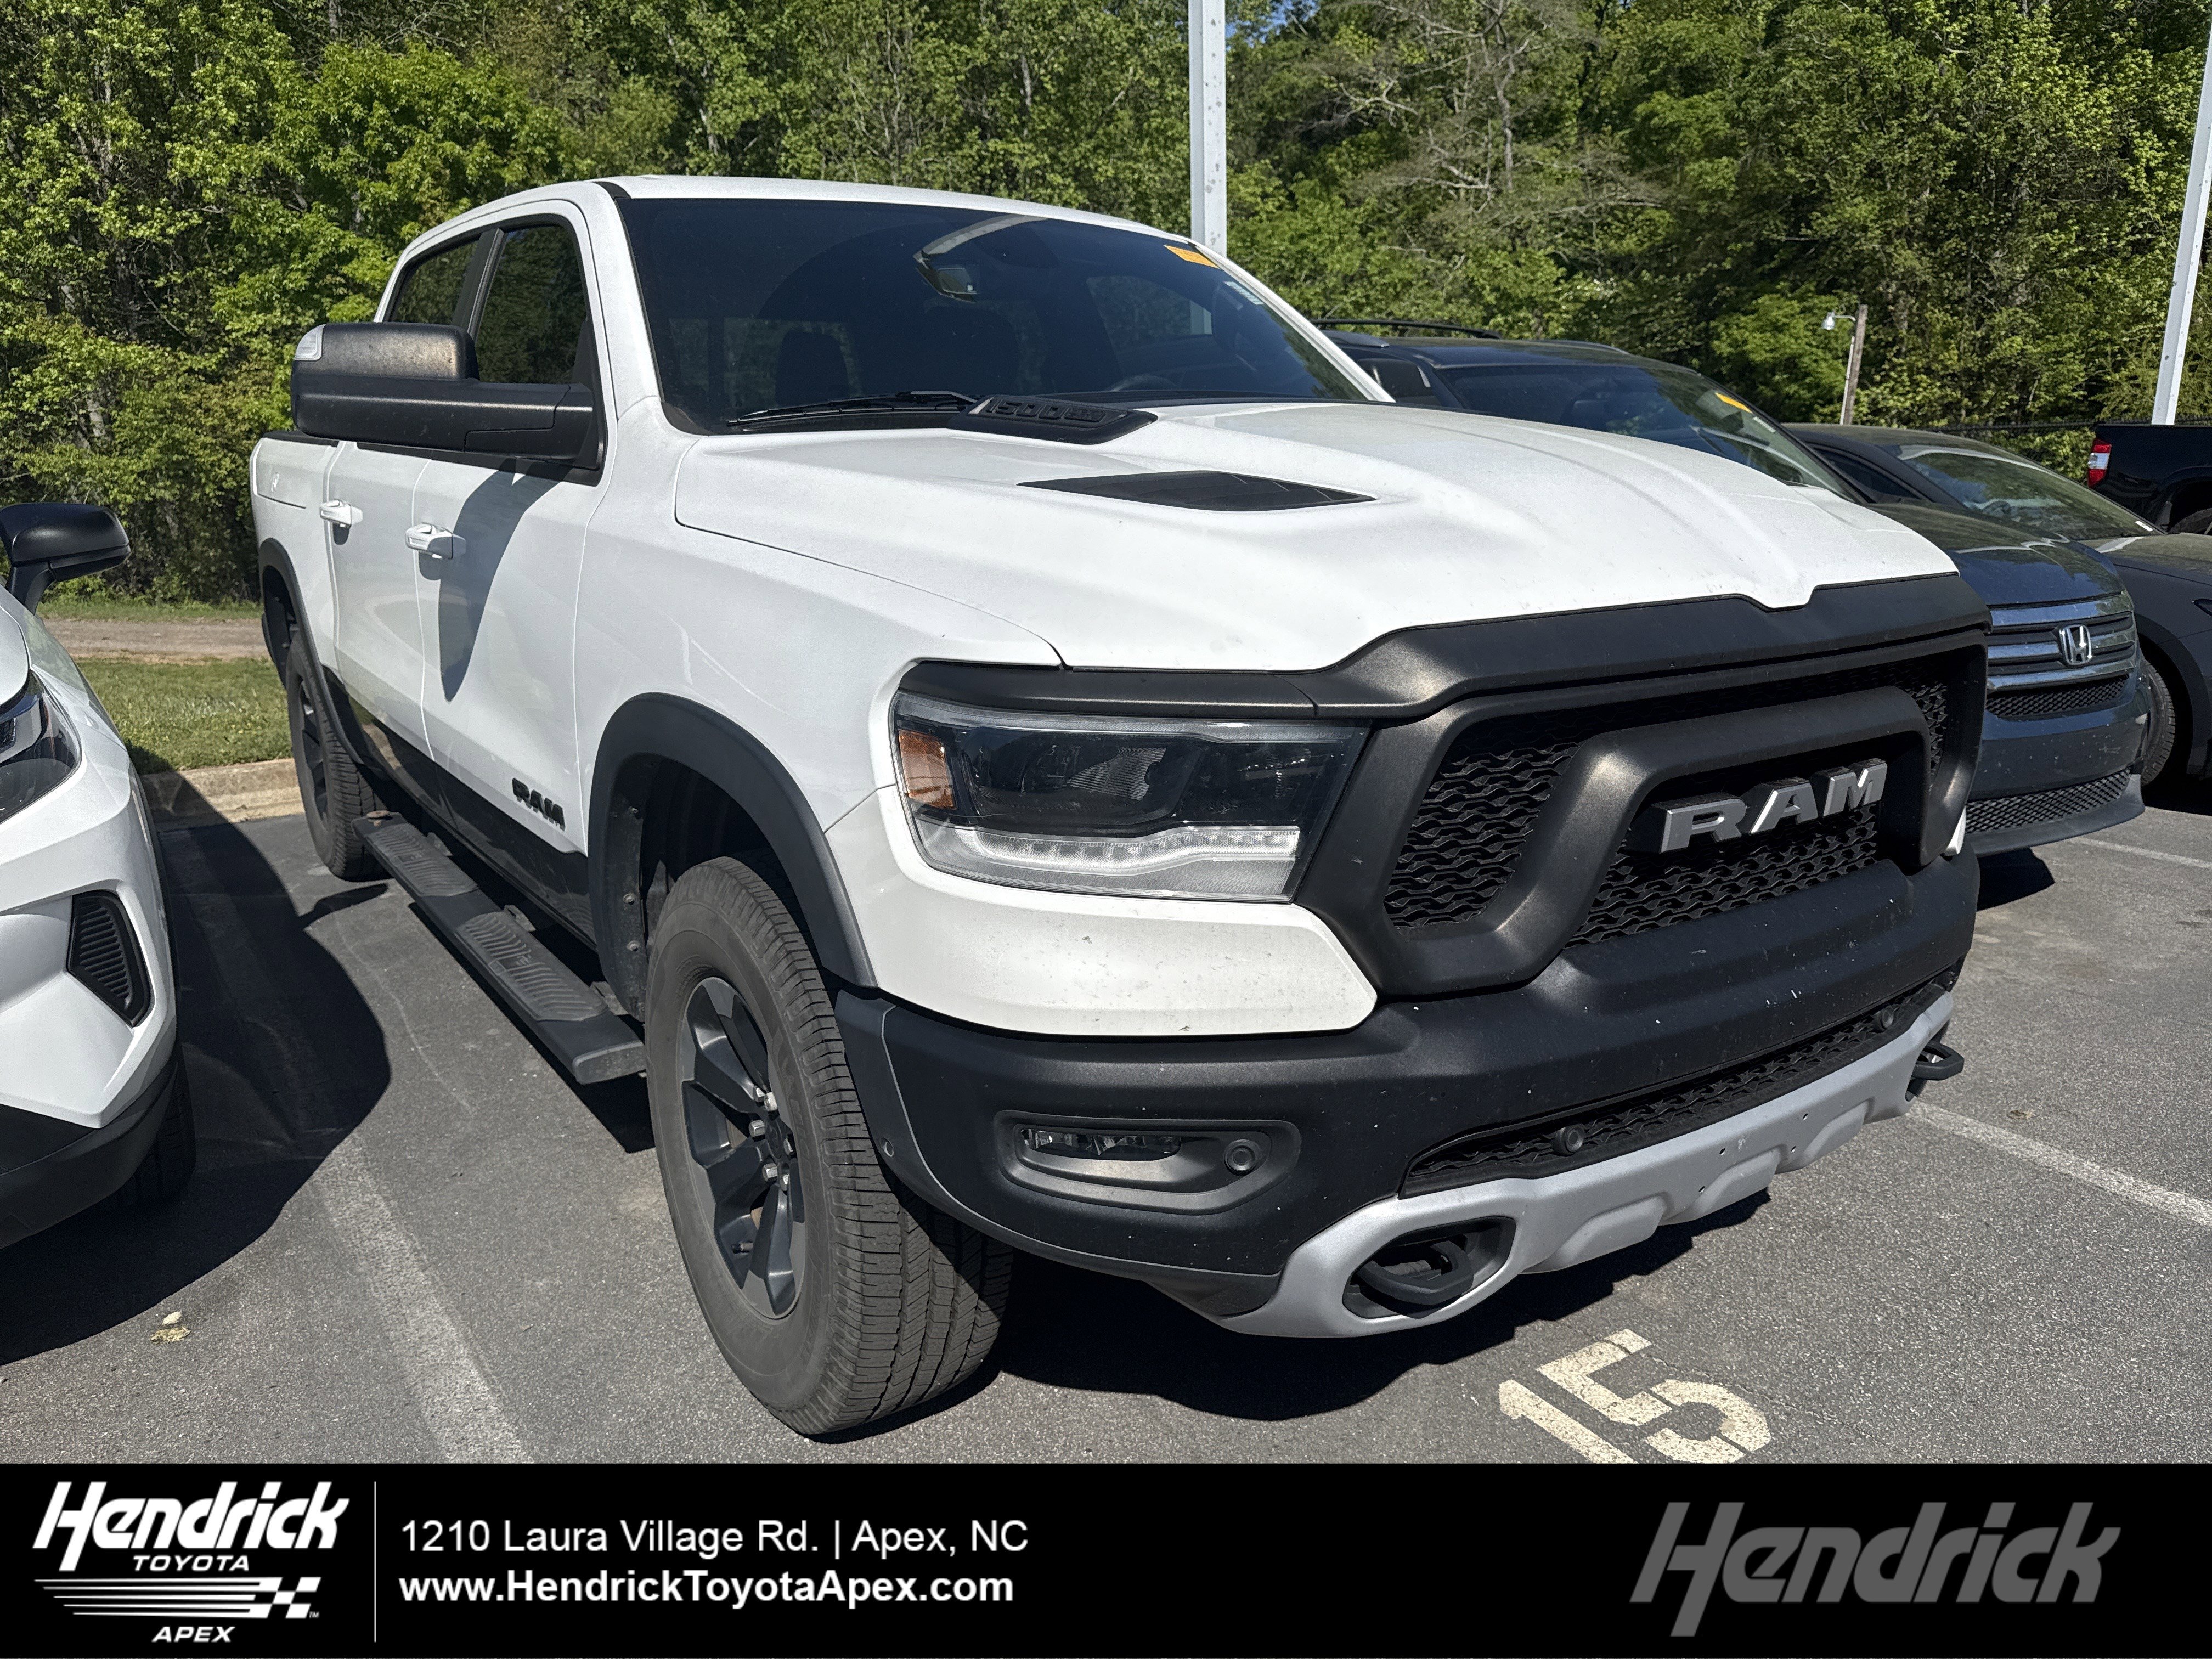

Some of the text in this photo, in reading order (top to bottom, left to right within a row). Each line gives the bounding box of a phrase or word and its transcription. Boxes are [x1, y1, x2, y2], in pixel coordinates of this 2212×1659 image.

[986, 398, 1065, 421] 1500
[512, 778, 566, 831] RAM
[1659, 759, 1888, 854] RAM
[1498, 1329, 1771, 1464] 15
